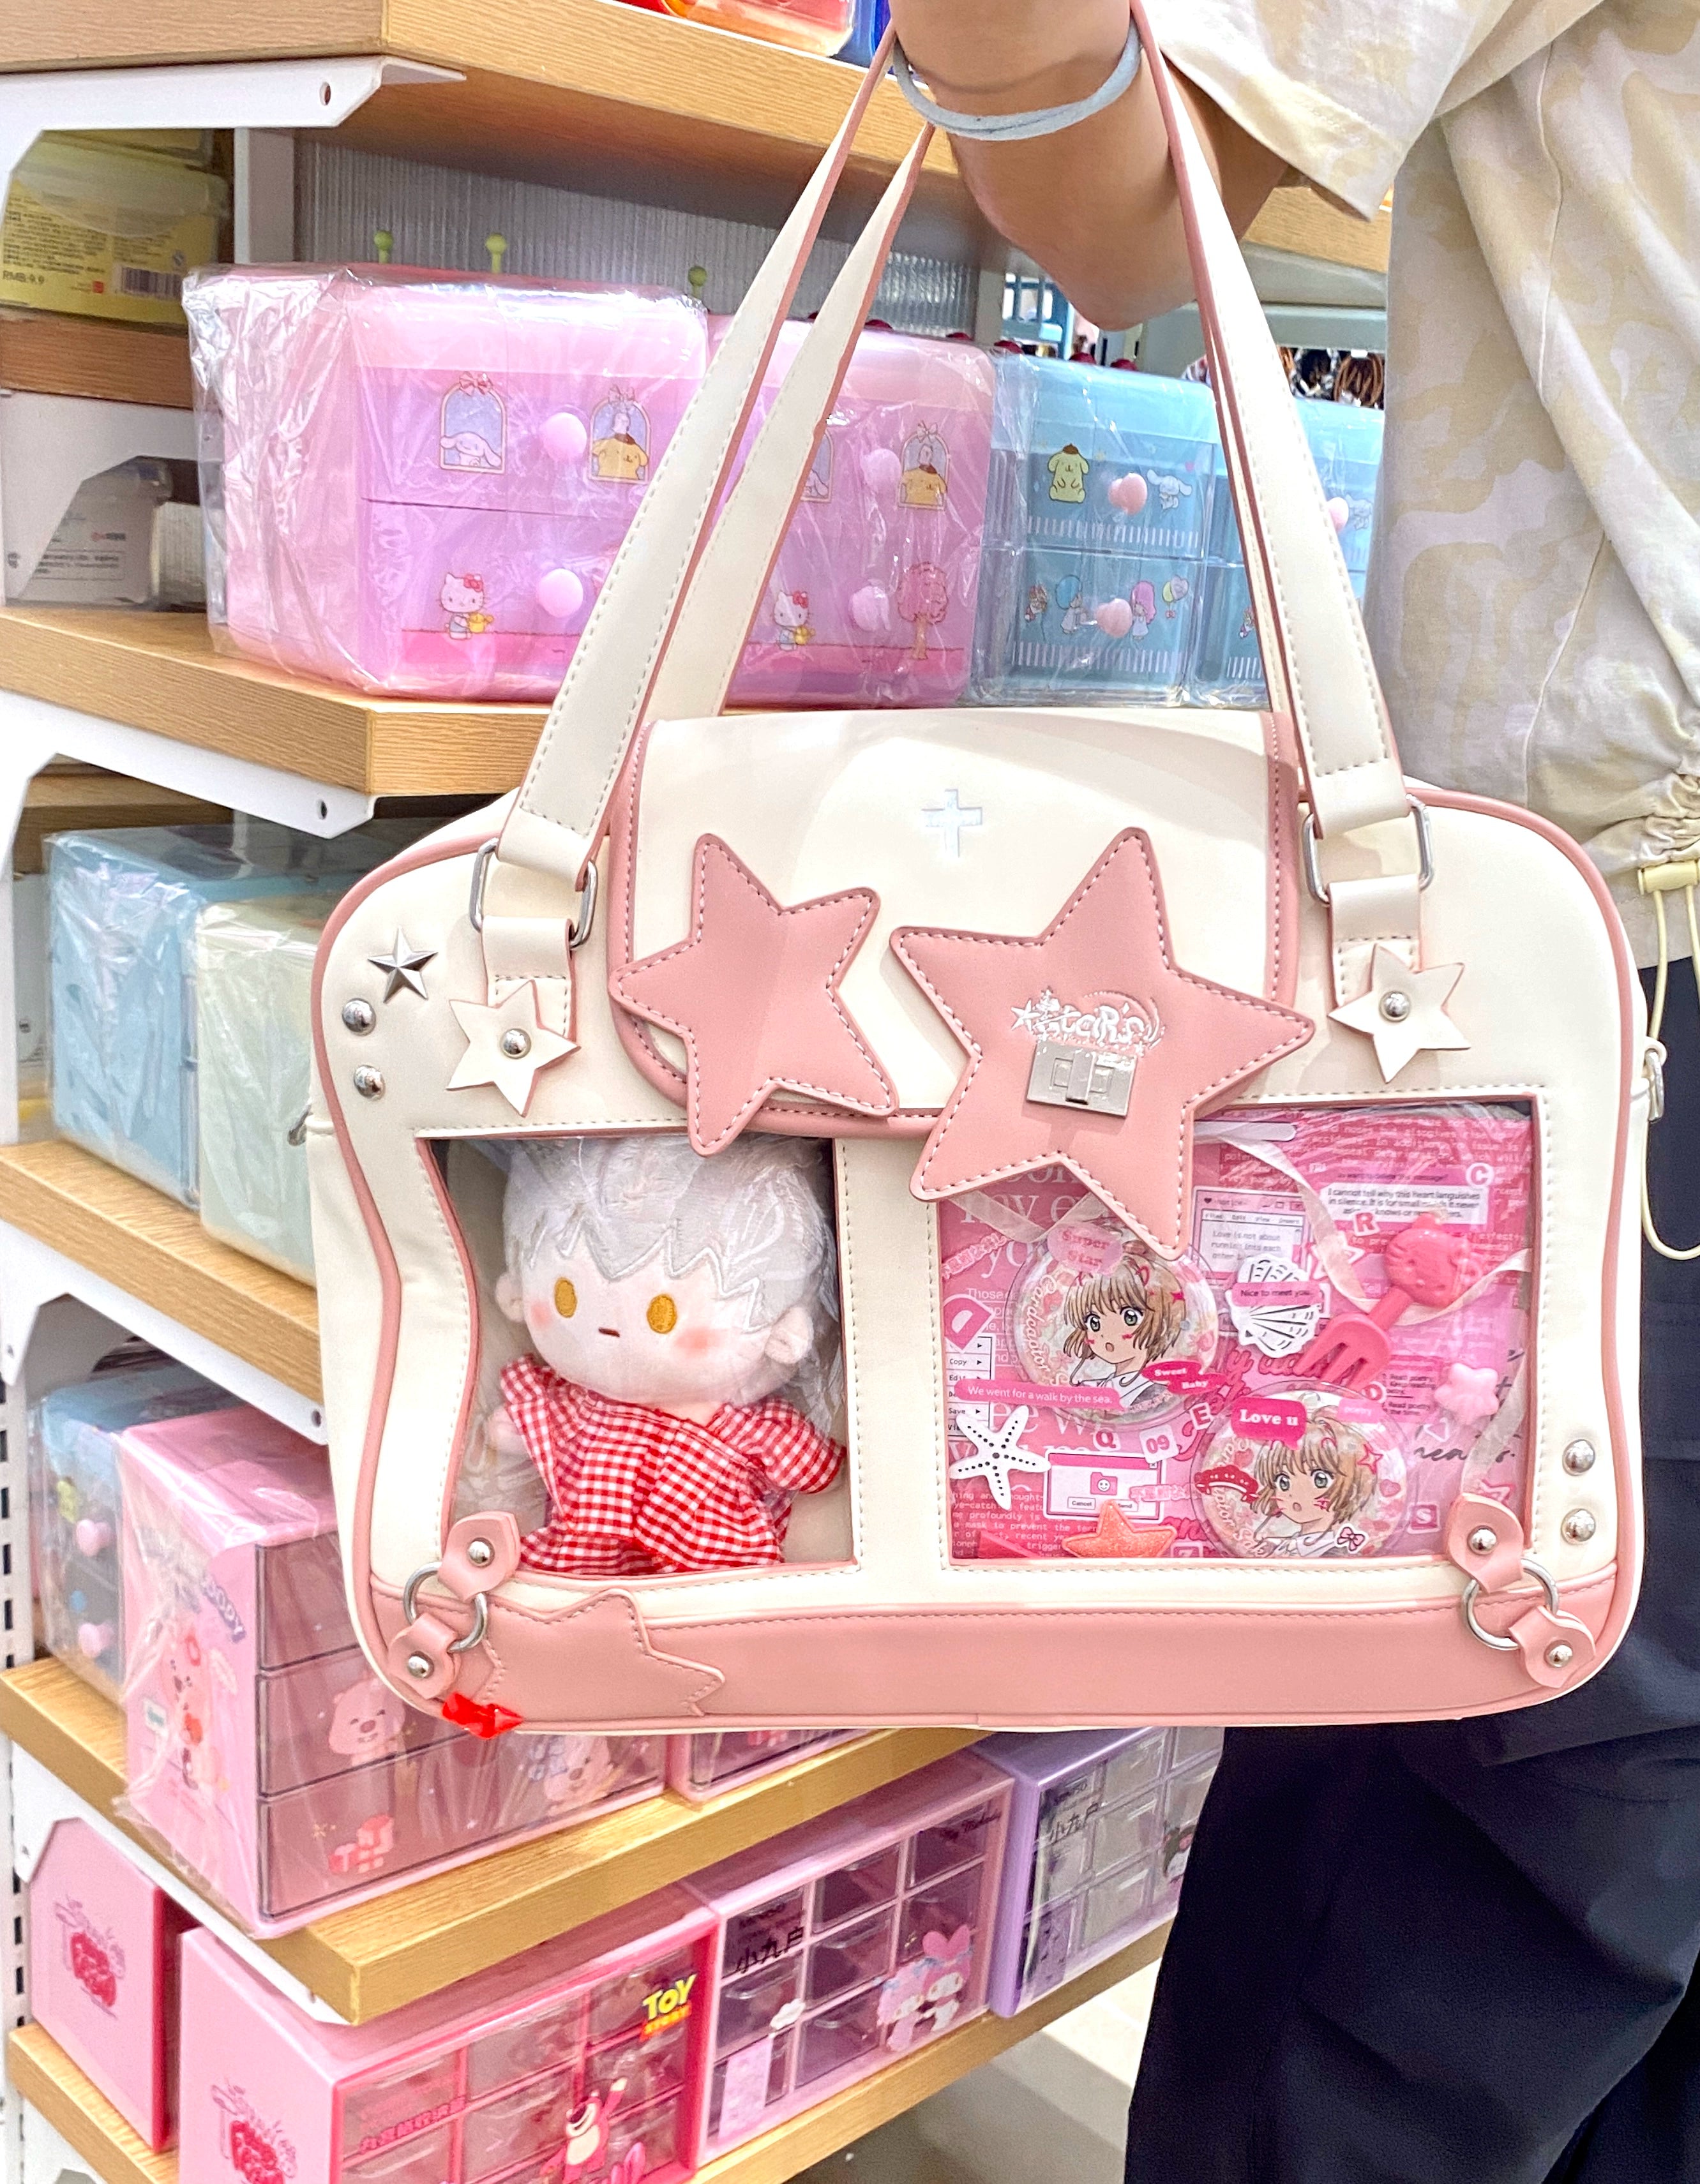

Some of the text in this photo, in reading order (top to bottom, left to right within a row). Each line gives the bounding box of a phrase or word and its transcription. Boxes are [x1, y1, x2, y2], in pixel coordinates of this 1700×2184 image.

[1471, 1165, 1488, 1185] C
[1355, 1212, 1375, 1232] R
[1154, 1368, 1187, 1377] Sweet
[1182, 1380, 1208, 1389] Baby
[967, 1386, 984, 1395] We
[986, 1389, 1010, 1397] went
[1012, 1389, 1026, 1398] for
[1036, 1393, 1058, 1401] walk
[1060, 1394, 1072, 1404] by
[1074, 1395, 1090, 1403] the
[1192, 1405, 1211, 1426] E
[1239, 1409, 1300, 1426] Love u
[1095, 1430, 1117, 1449] Q
[1146, 1434, 1170, 1455] 09
[950, 1490, 975, 1501] hing
[969, 1511, 1023, 1522] profoundly
[1417, 1507, 1433, 1525] S
[1010, 1523, 1048, 1532] prevent
[1077, 1523, 1097, 1532] terr
[1015, 1532, 1048, 1540] recent
[641, 1973, 698, 2021] TOY
